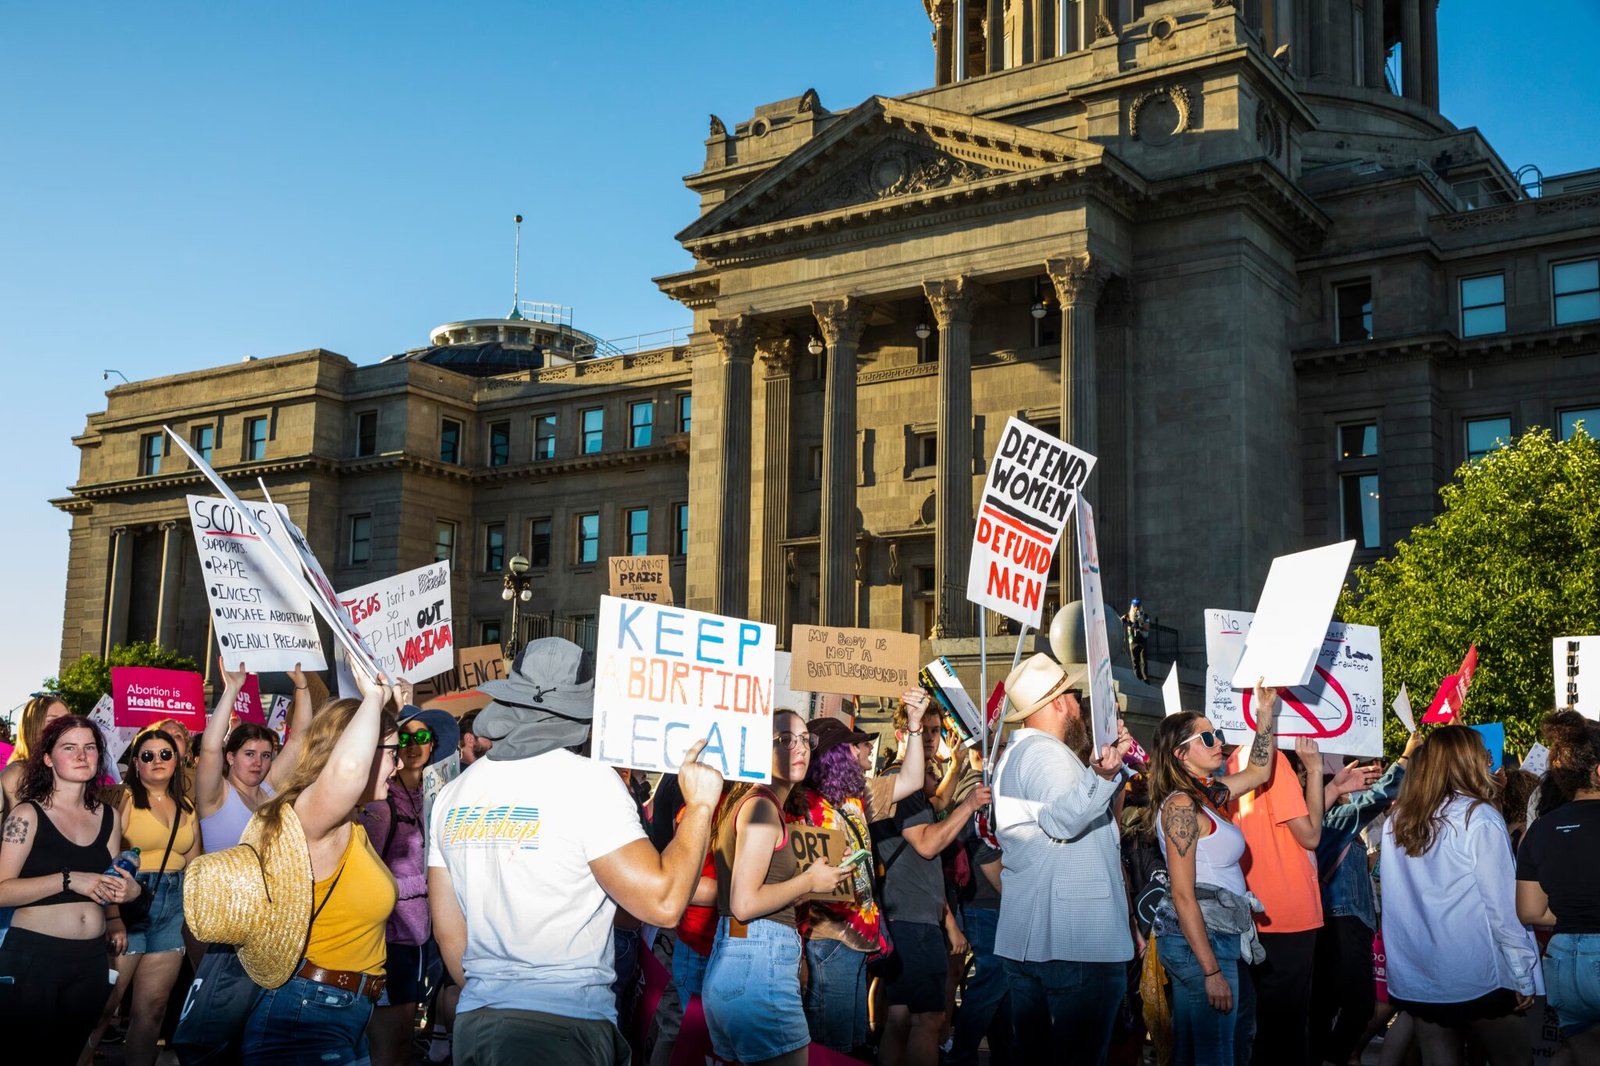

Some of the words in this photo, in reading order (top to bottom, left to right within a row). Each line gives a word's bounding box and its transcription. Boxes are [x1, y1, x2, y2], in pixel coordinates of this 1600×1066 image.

[1001, 425, 1087, 490] DEFEND
[991, 458, 1073, 522] WOMEN
[976, 516, 1051, 574] DEFUND
[611, 559, 635, 573] YOU
[636, 558, 665, 571] CANNOT
[620, 571, 663, 586] PRAISE
[987, 561, 1042, 611] MEN
[215, 583, 262, 604] INCEST
[221, 607, 266, 621] UNSAFE
[270, 609, 314, 625] ABORTIONS
[386, 618, 413, 642] HIM
[417, 599, 445, 629] OUT
[228, 632, 270, 650] DEADLY
[273, 632, 321, 651] PREGNANCY
[617, 603, 761, 667] KEEP
[808, 628, 829, 644] MY
[838, 632, 867, 649] BODY
[876, 638, 888, 651] IS
[396, 624, 453, 674] VAGINA
[825, 646, 855, 661] NOT
[862, 649, 873, 663] A
[126, 683, 170, 697] Abortion
[172, 687, 181, 698] is
[602, 655, 772, 717] ABORTION
[127, 696, 165, 709] Health
[166, 698, 196, 711] Care.
[1356, 703, 1370, 713] NOT
[599, 710, 766, 780] LEGAL
